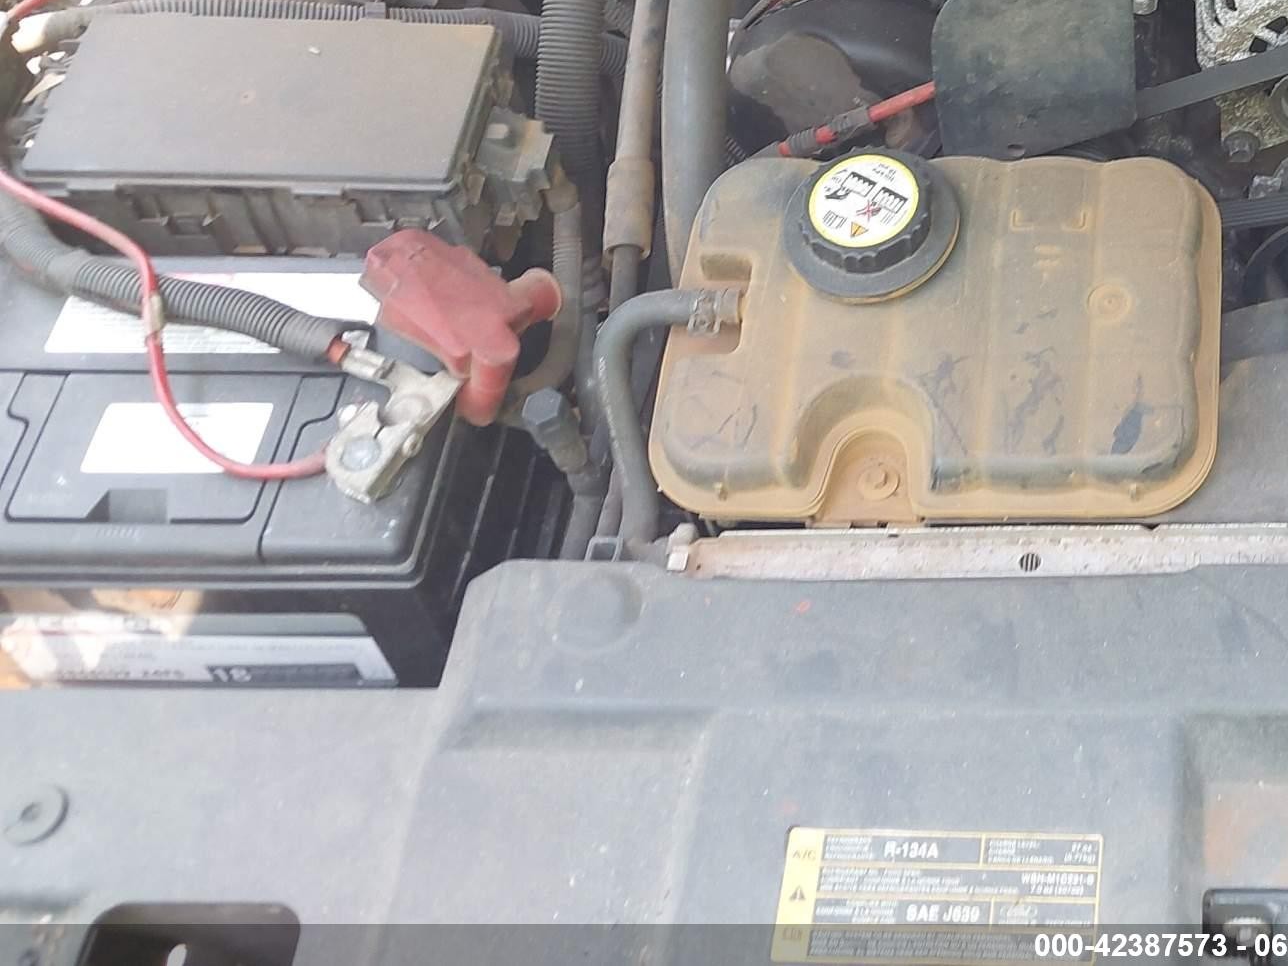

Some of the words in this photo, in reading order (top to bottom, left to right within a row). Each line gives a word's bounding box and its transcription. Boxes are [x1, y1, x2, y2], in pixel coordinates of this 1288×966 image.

[883, 840, 939, 859] R-134A
[905, 903, 939, 922] SAE
[942, 904, 980, 923] J639
